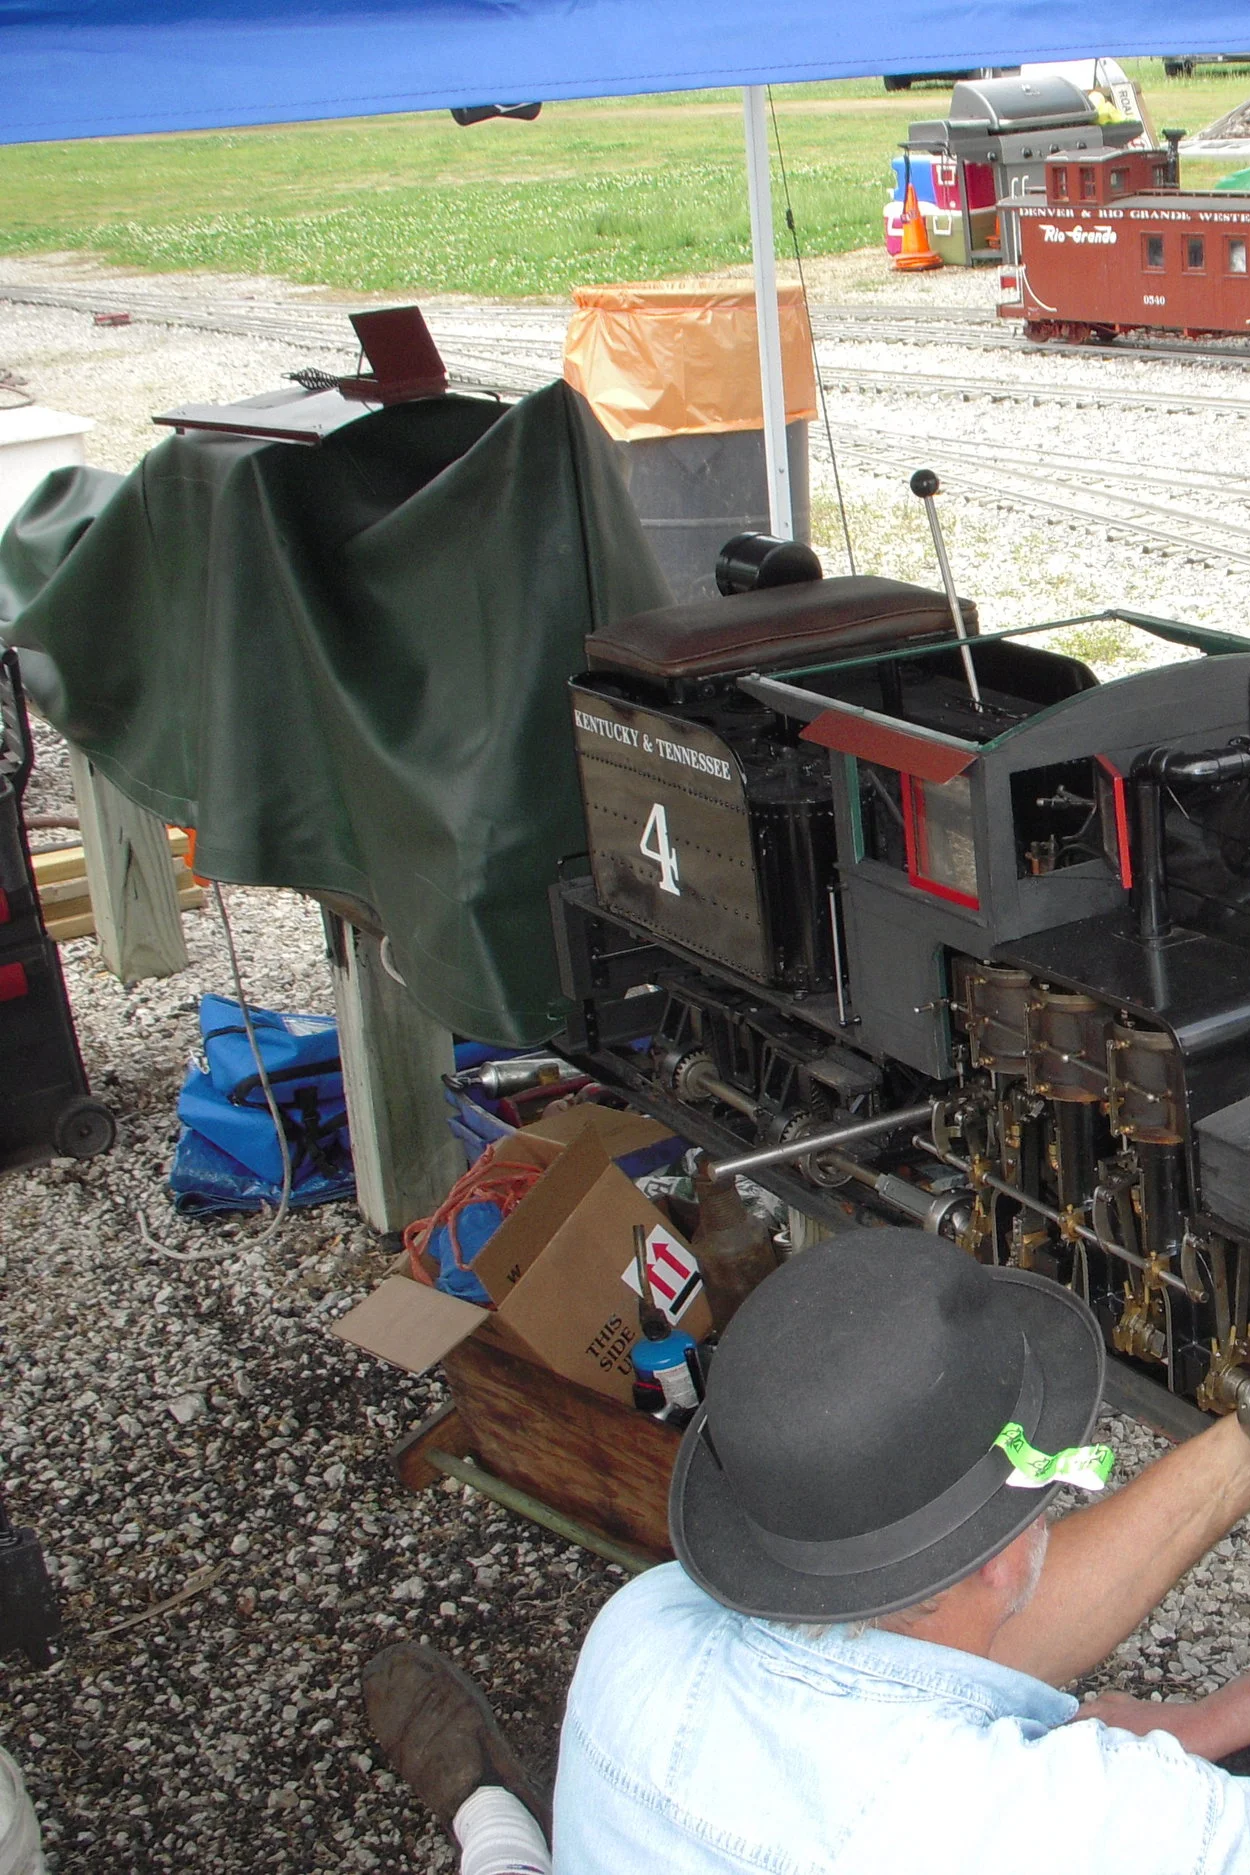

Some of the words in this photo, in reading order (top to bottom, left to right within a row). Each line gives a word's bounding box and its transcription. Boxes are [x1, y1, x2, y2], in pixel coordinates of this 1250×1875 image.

[1019, 207, 1074, 218] DENVER
[1081, 209, 1092, 218] &
[1099, 209, 1124, 218] RIO
[1129, 210, 1191, 221] GRANDE
[1039, 224, 1065, 243] Rio
[1065, 225, 1117, 244] Grande
[574, 709, 640, 748] KENTUCKY
[643, 733, 653, 753] &
[656, 738, 731, 781] TENNESSEE
[640, 802, 681, 897] 4
[585, 1313, 623, 1358] THIS
[600, 1326, 636, 1372] SIDE
[618, 1354, 633, 1376] U
